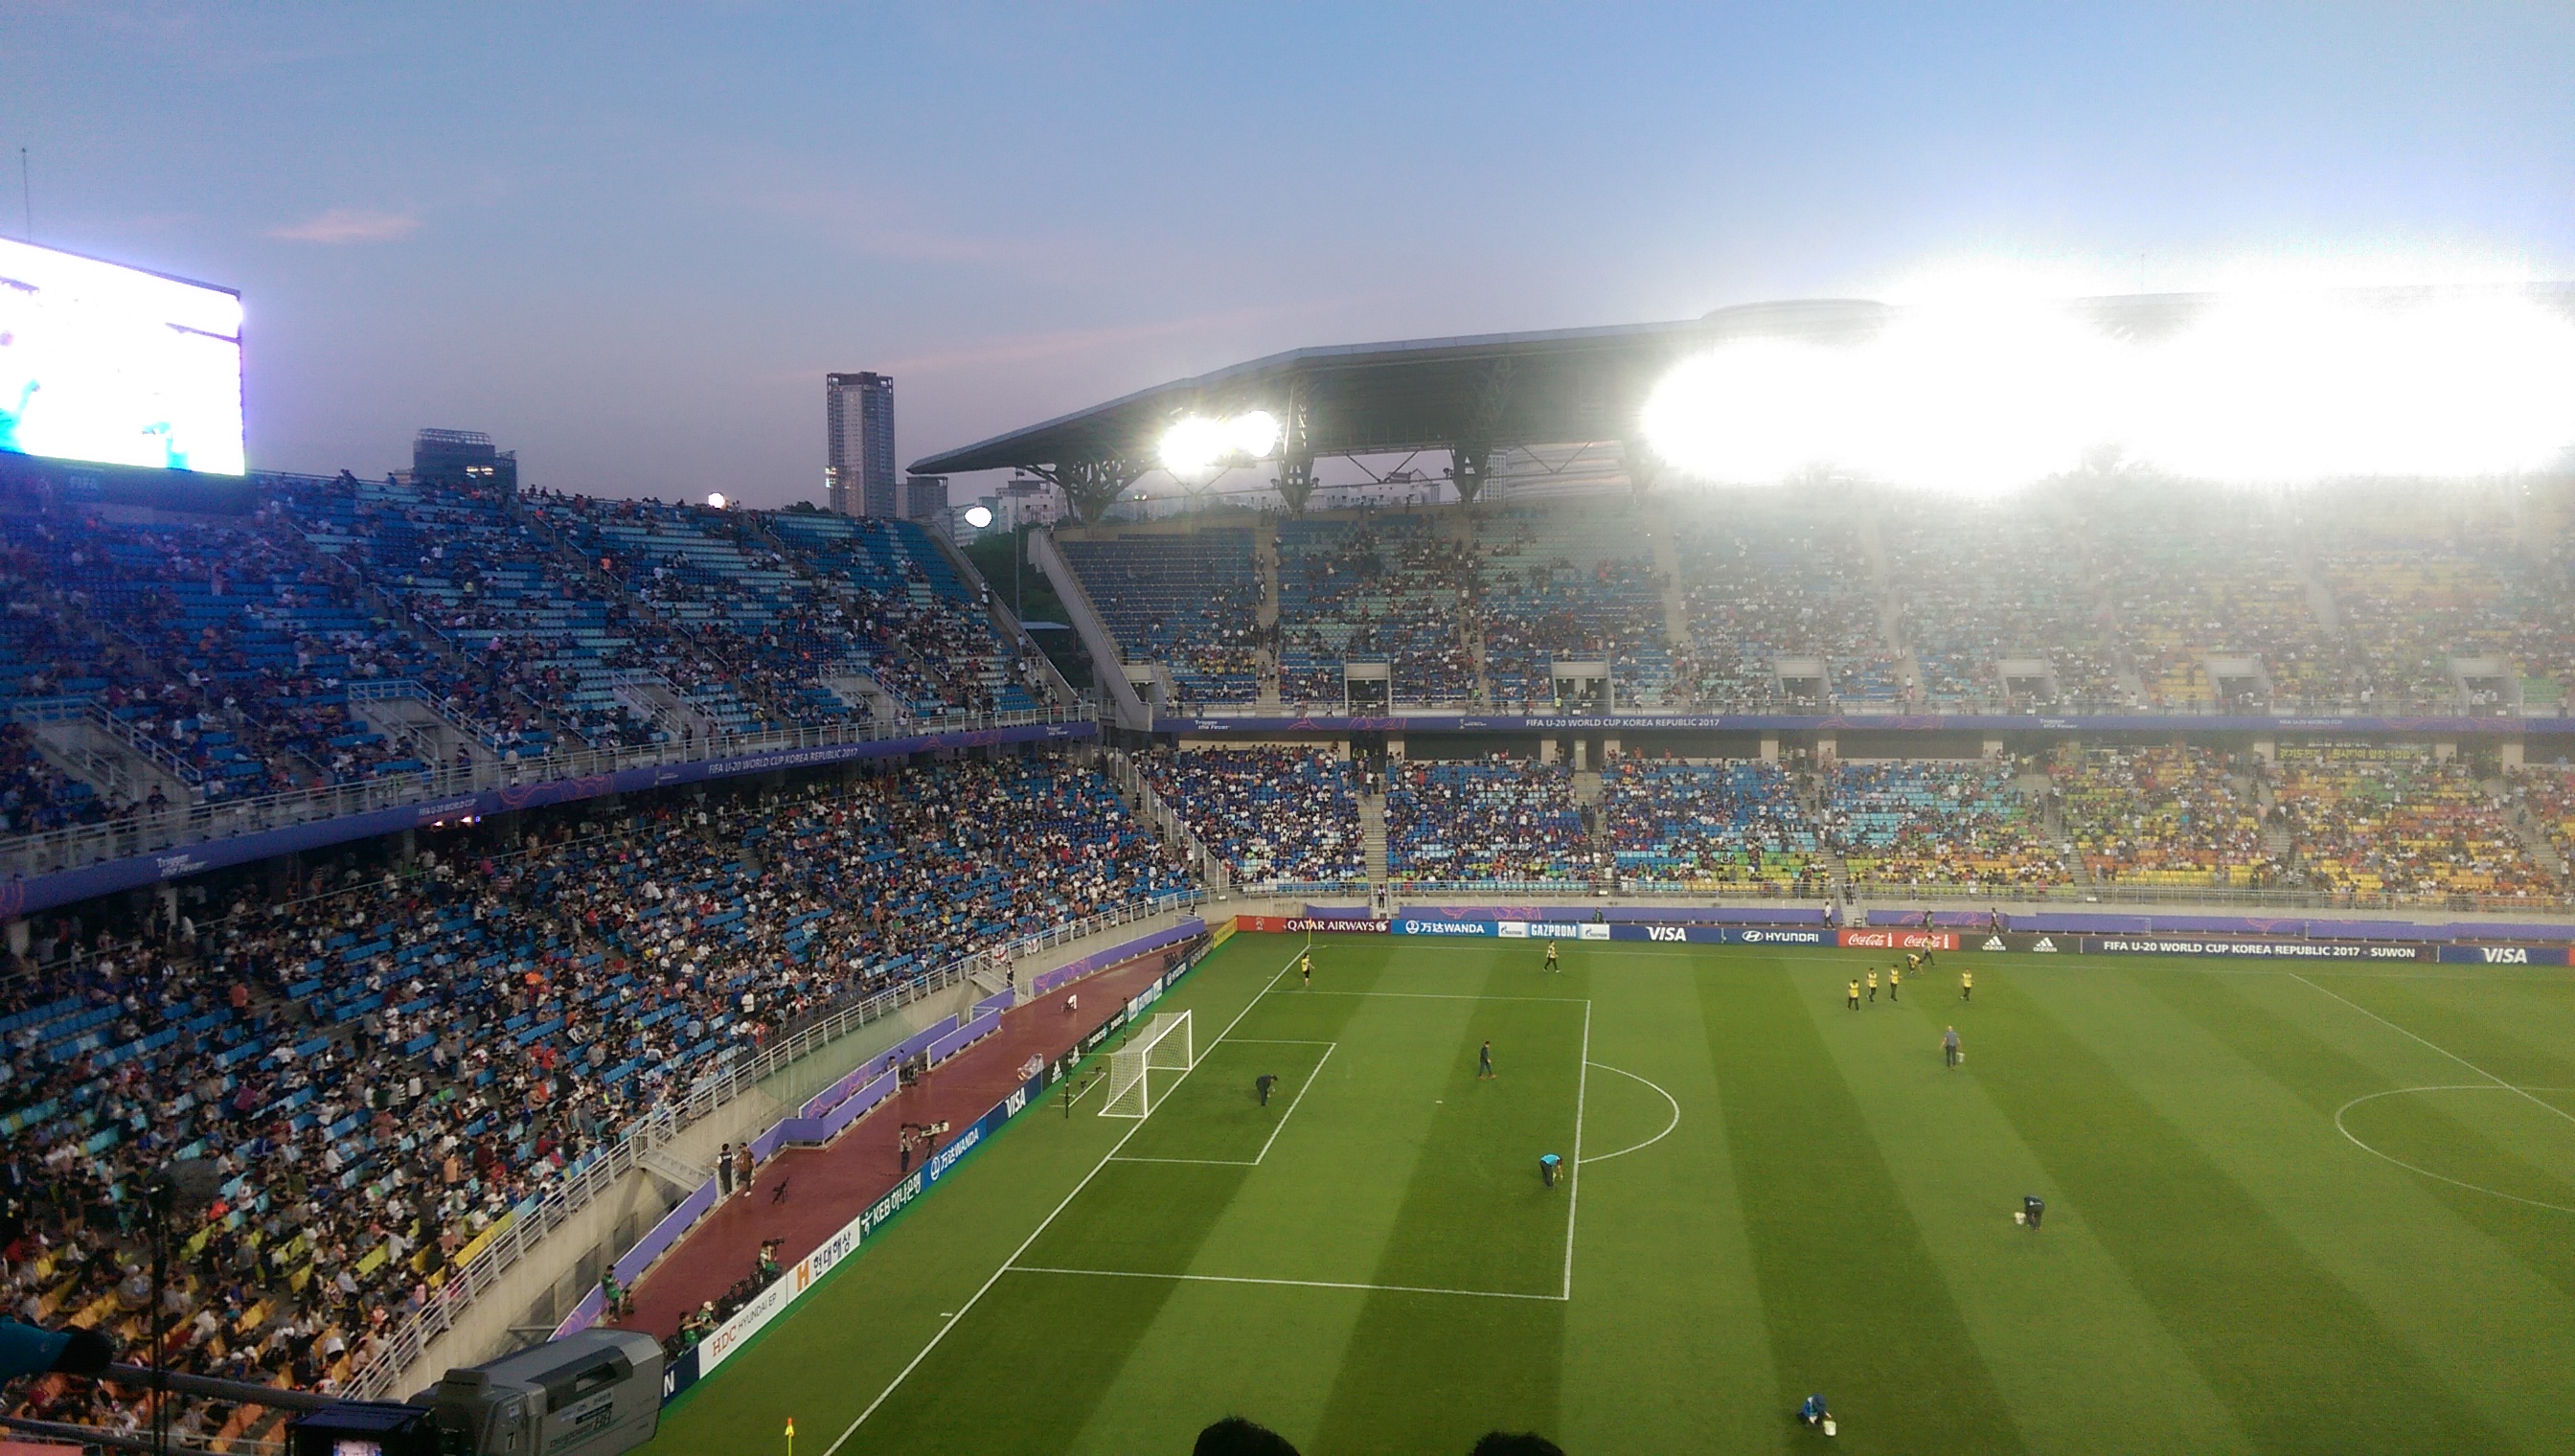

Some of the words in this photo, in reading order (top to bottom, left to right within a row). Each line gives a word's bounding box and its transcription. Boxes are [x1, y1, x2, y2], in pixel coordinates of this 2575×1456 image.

[708, 762, 724, 775] FIFA
[725, 761, 741, 772] U-20
[742, 757, 769, 770] WORLD
[770, 755, 785, 766] CUP
[785, 753, 809, 764] KOREA
[809, 749, 842, 762] REPUBLIC
[842, 747, 858, 759] 2017
[1287, 920, 1324, 932] QATAR
[1327, 921, 1375, 931] AIRWAYS
[1531, 923, 1577, 937] GAZPROM
[1646, 926, 1687, 942] VISA
[1766, 933, 1819, 943] HYUNDAI
[2104, 941, 2129, 951] FIFA
[2131, 942, 2157, 951] U-20
[2160, 943, 2202, 953] WORLD
[2205, 944, 2229, 953] CUP
[2232, 944, 2271, 954] KOREA
[2275, 945, 2330, 956] REPUBLIC
[2333, 946, 2360, 957] 2017
[2371, 947, 2416, 958] SUWON
[2481, 947, 2528, 964] VISA
[1005, 1086, 1026, 1118] VISA
[873, 1197, 891, 1226] KEB
[891, 1172, 922, 1211] 하나은행
[813, 1230, 852, 1279] 현대해상
[712, 1325, 738, 1357] HDC
[738, 1297, 767, 1332] HYUNDAI
